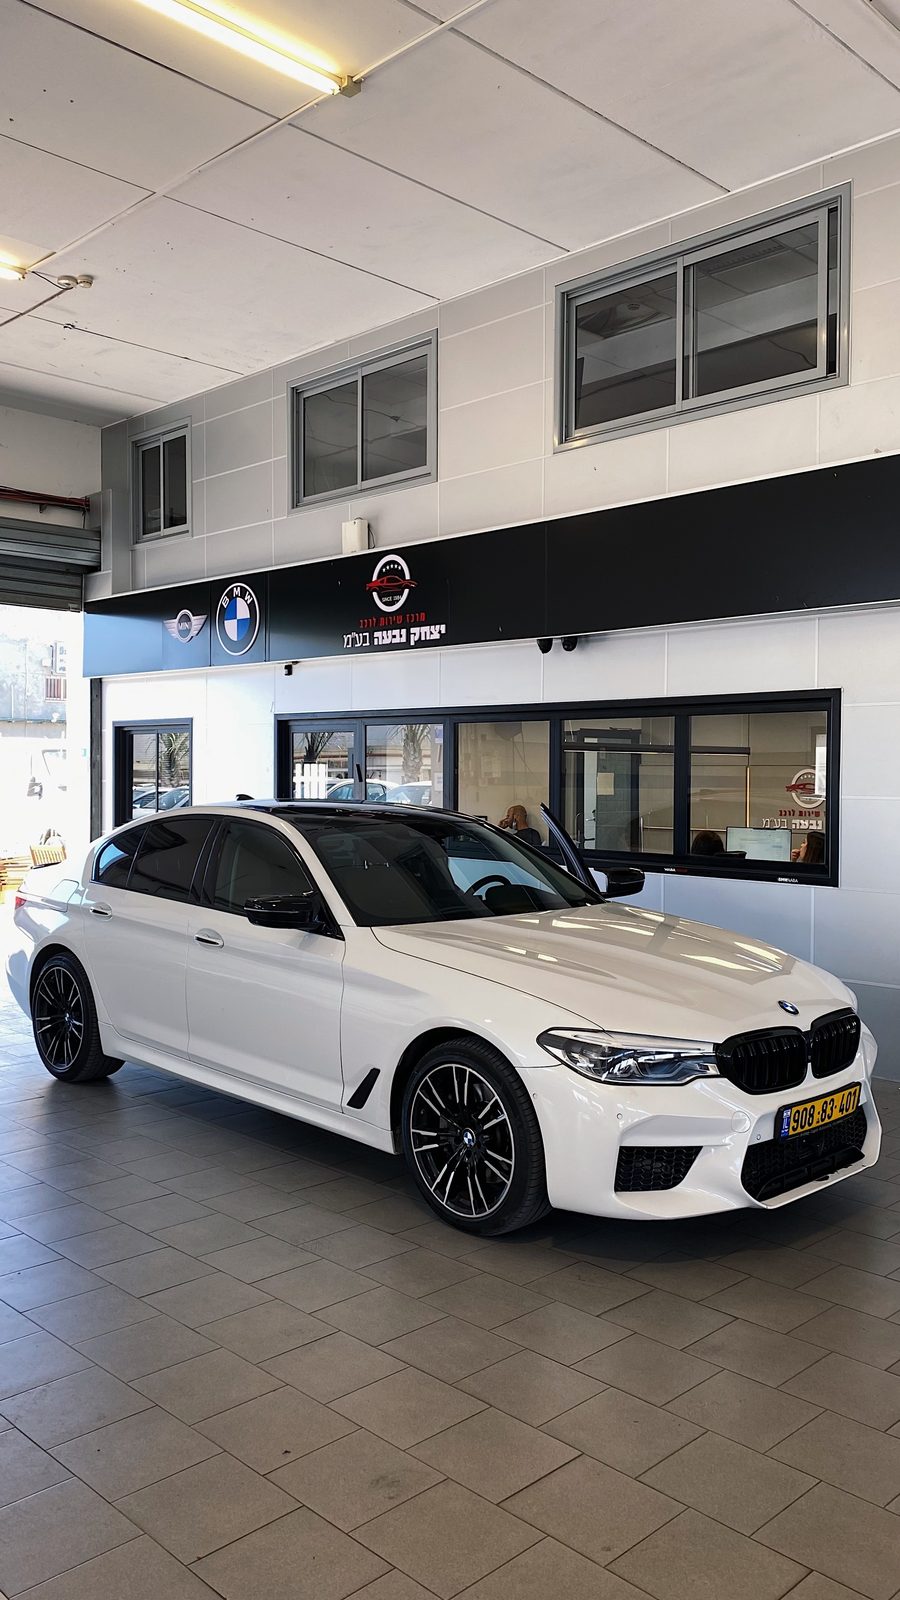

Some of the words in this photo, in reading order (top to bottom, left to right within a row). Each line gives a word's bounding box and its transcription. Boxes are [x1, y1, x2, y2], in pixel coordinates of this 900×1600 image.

[221, 586, 254, 609] BMW
[359, 615, 377, 629] לרכב
[380, 614, 403, 627] שירות
[405, 612, 426, 624] מרכז
[373, 628, 407, 646] נבעה
[410, 624, 447, 646] יצחק
